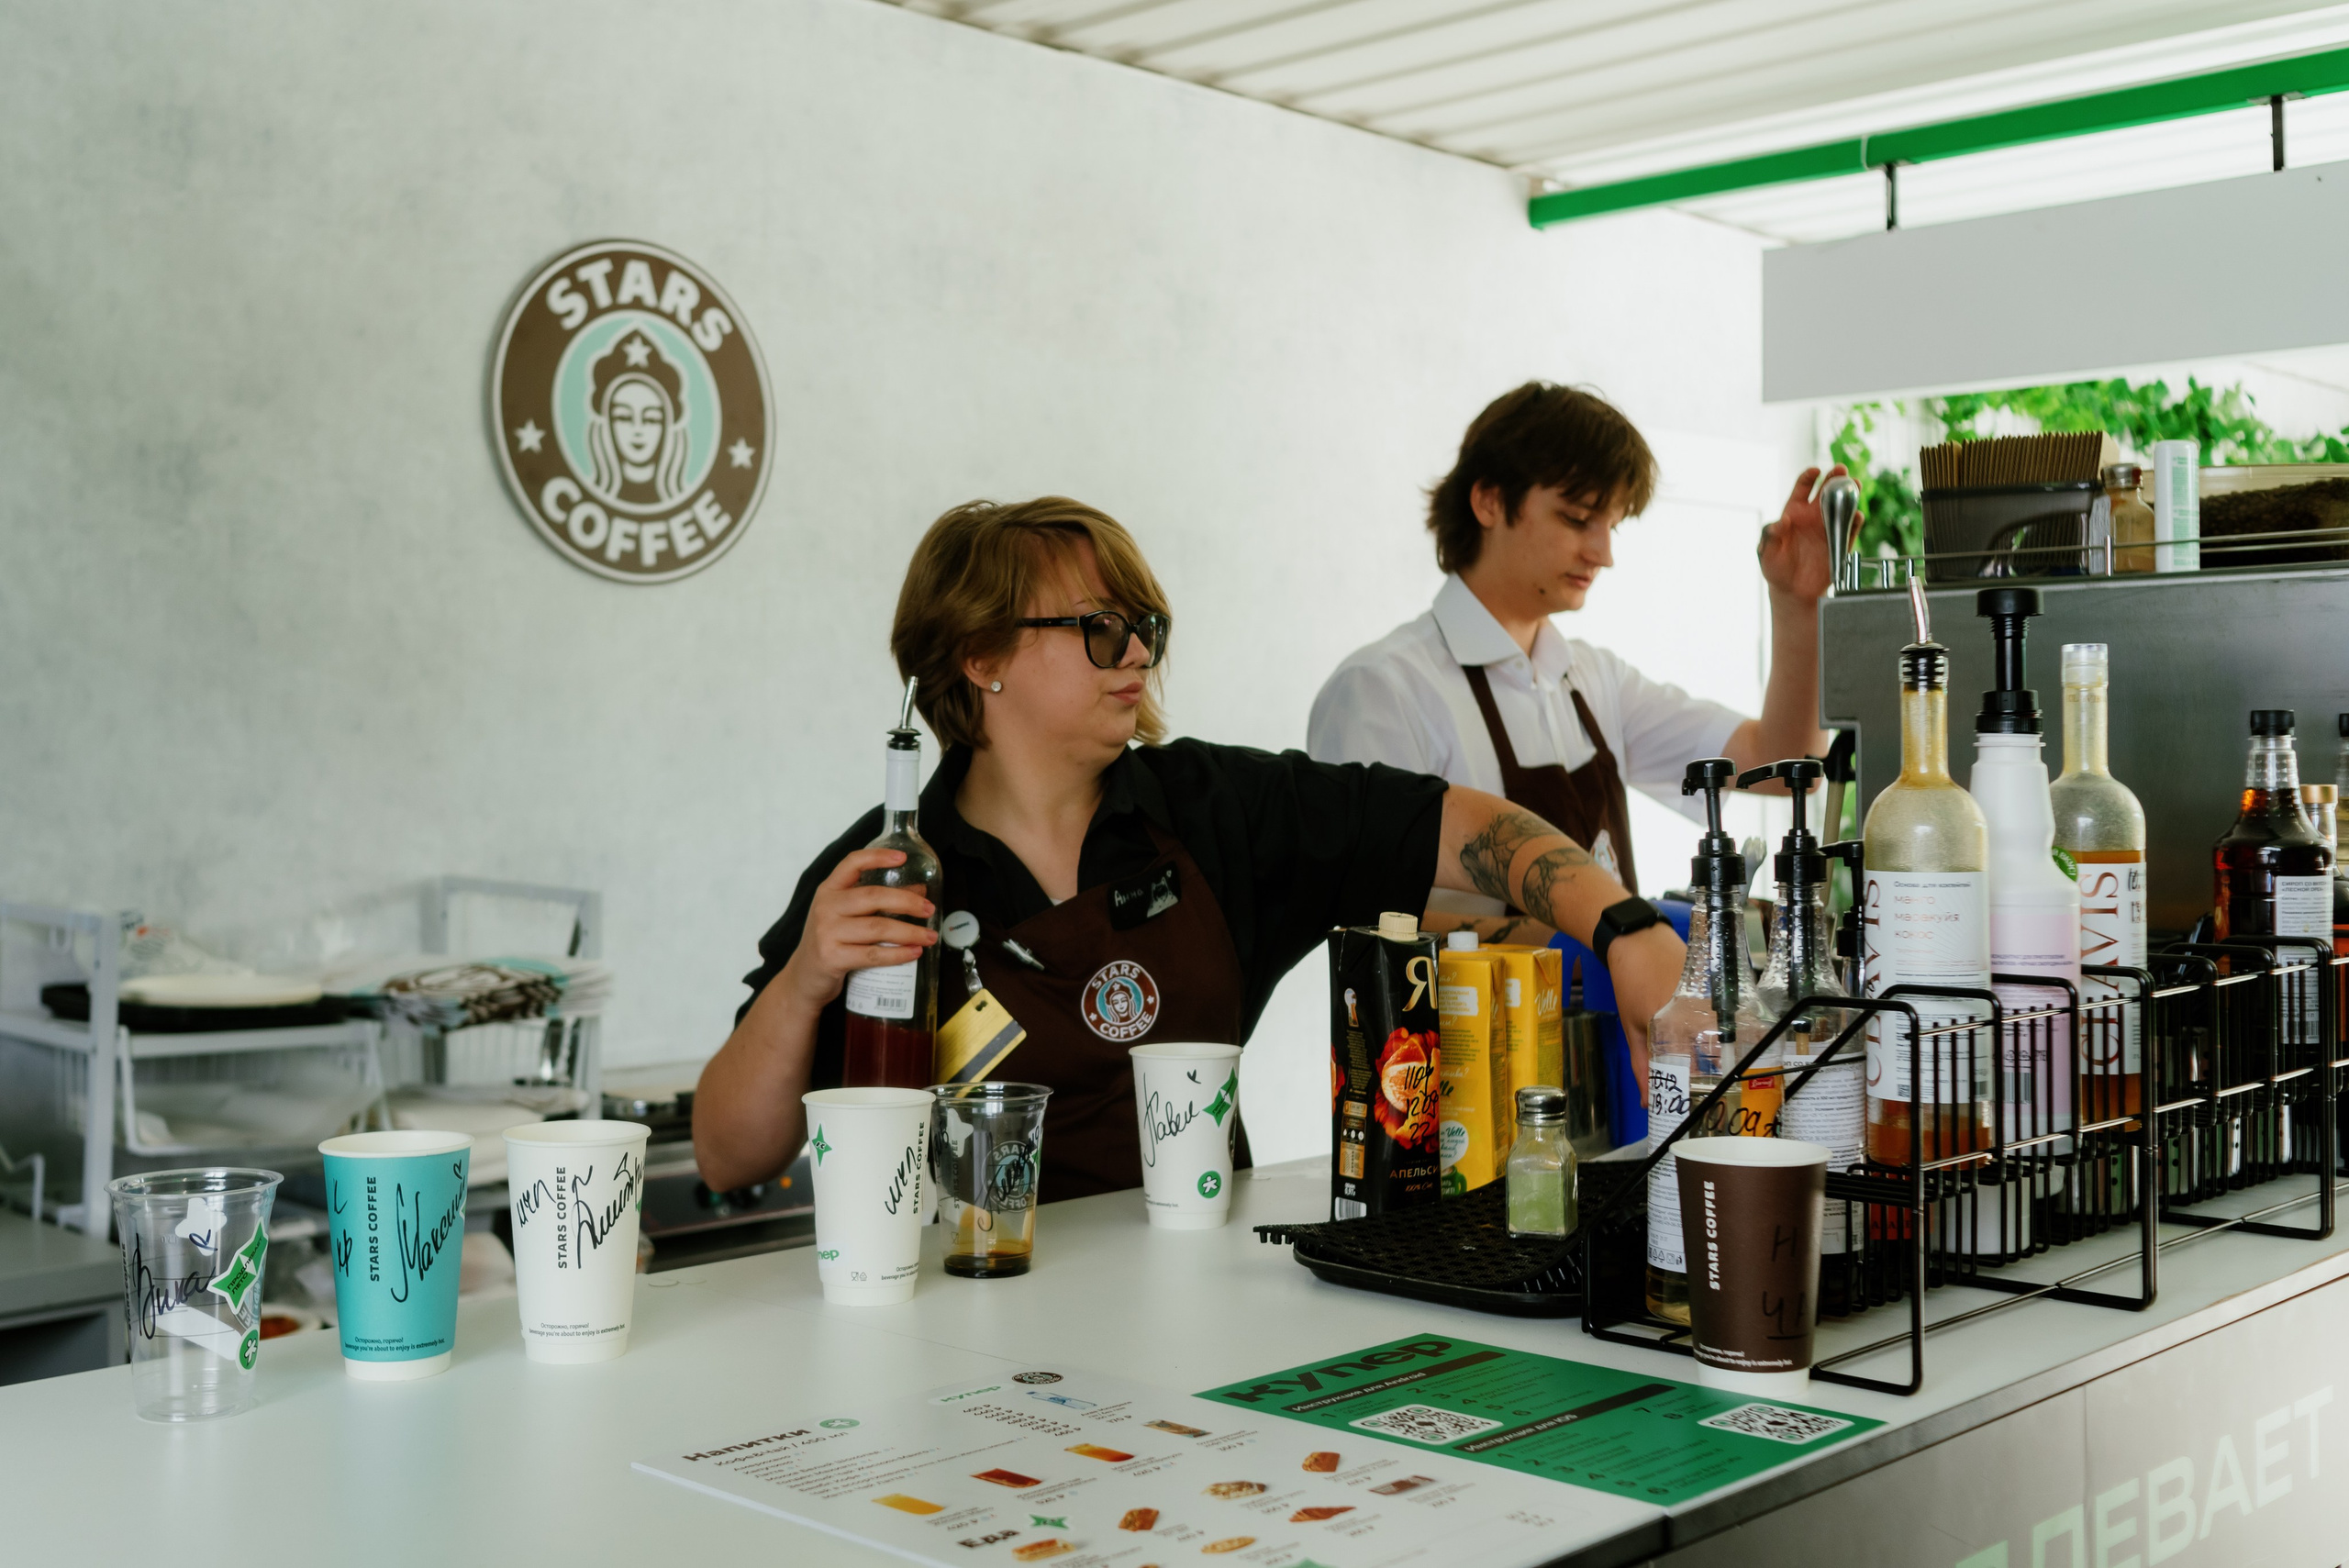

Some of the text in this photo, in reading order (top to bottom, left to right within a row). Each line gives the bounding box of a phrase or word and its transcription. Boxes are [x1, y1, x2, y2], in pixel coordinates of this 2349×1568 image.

[546, 258, 733, 351] STARS
[540, 476, 732, 567] COFFEE
[1894, 895, 1935, 905] манго
[1894, 912, 1960, 923] маракуйя
[1894, 930, 1934, 940] кокос
[1092, 963, 1141, 990] STARS
[1402, 956, 1439, 1012] Я
[1534, 988, 1557, 1017] Velle
[1099, 1011, 1152, 1039] COFFEE
[913, 1121, 925, 1215] STARS COFFEE
[367, 1176, 380, 1282] STARS COFFEE
[556, 1167, 567, 1269] STARS COFFEE
[1703, 1180, 1720, 1291] STARS COFFEE
[818, 1250, 840, 1261] пер
[232, 1272, 249, 1295] ЛЕТО
[383, 1337, 404, 1345] горячо!
[416, 1340, 438, 1350] extremely
[582, 1329, 595, 1337] enjoy
[1221, 1340, 1453, 1404] купер
[941, 1385, 1002, 1402] купер
[1291, 1389, 1364, 1413] Инструкция
[1385, 1371, 1427, 1388] Android
[681, 1429, 812, 1462] Напитки
[1464, 1428, 1536, 1453] Инструкция
[957, 1529, 1021, 1550] Еда
